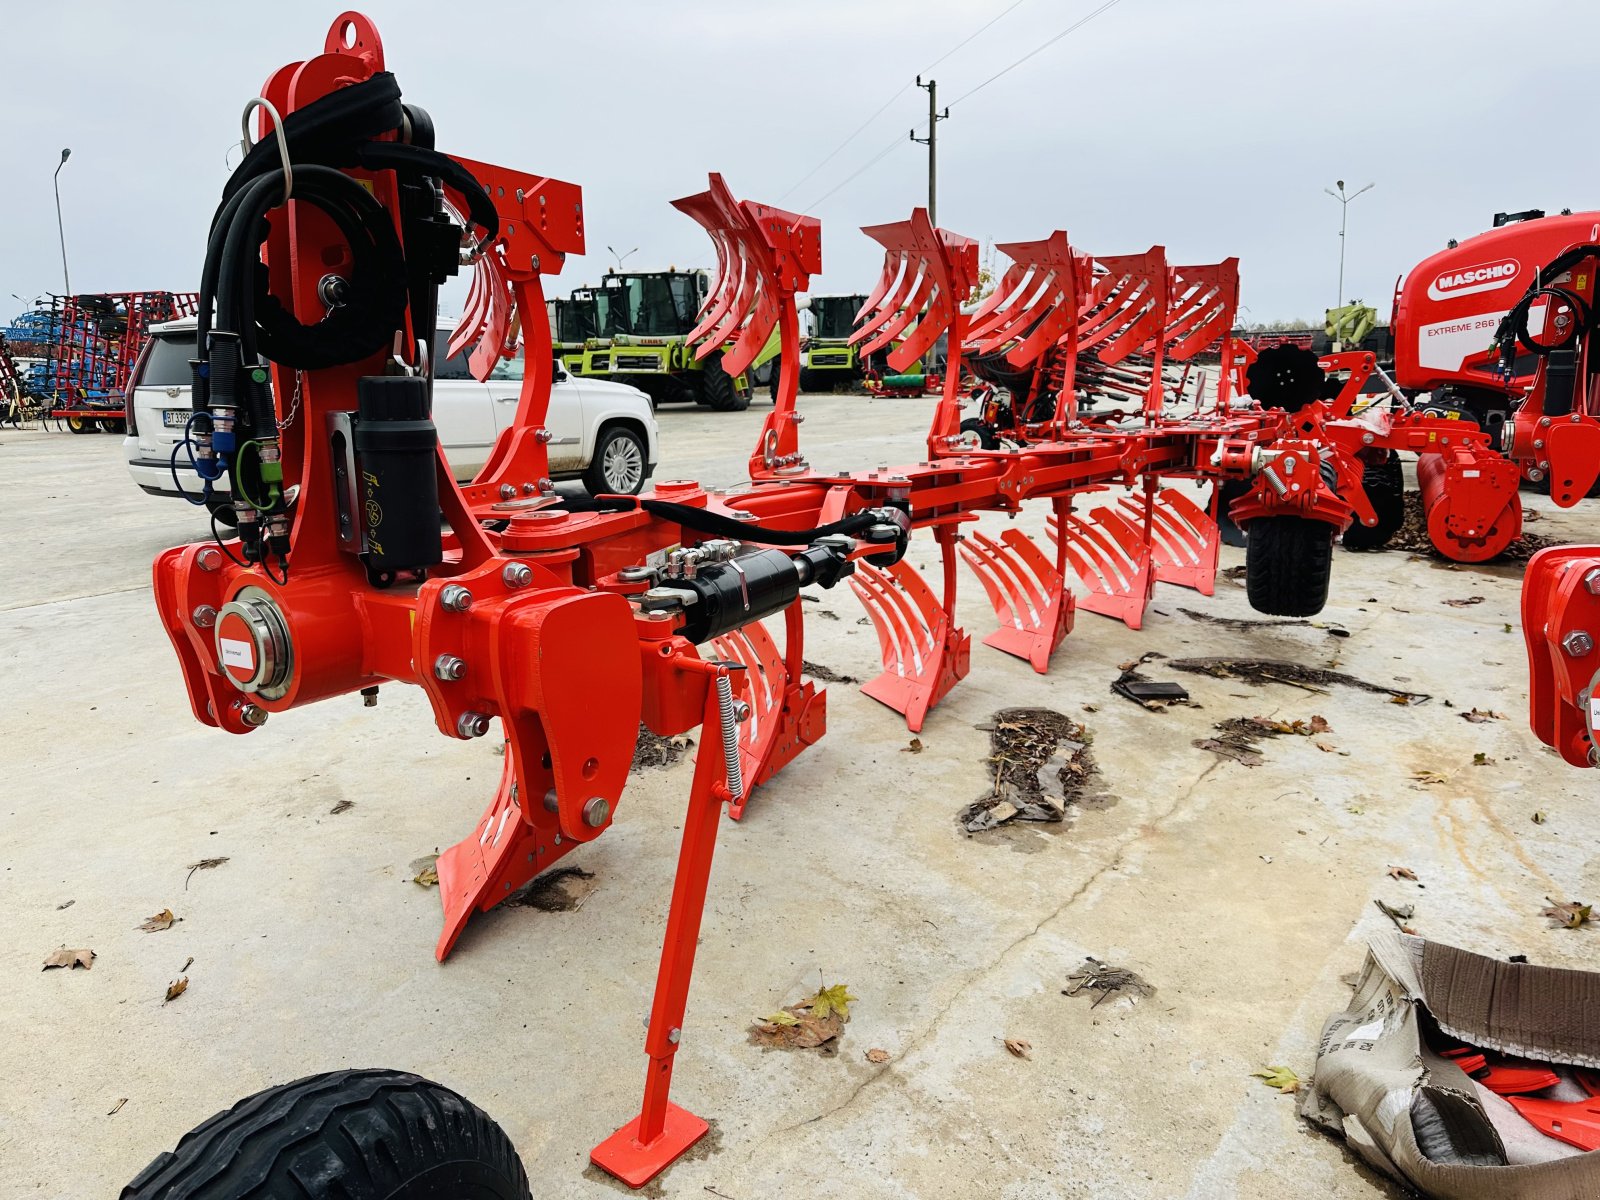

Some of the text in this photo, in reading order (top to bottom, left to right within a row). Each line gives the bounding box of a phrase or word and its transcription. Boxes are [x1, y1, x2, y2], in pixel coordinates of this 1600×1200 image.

[1438, 263, 1516, 289] MASCHIO
[1427, 323, 1472, 336] EXTREME
[1475, 320, 1495, 329] 266
